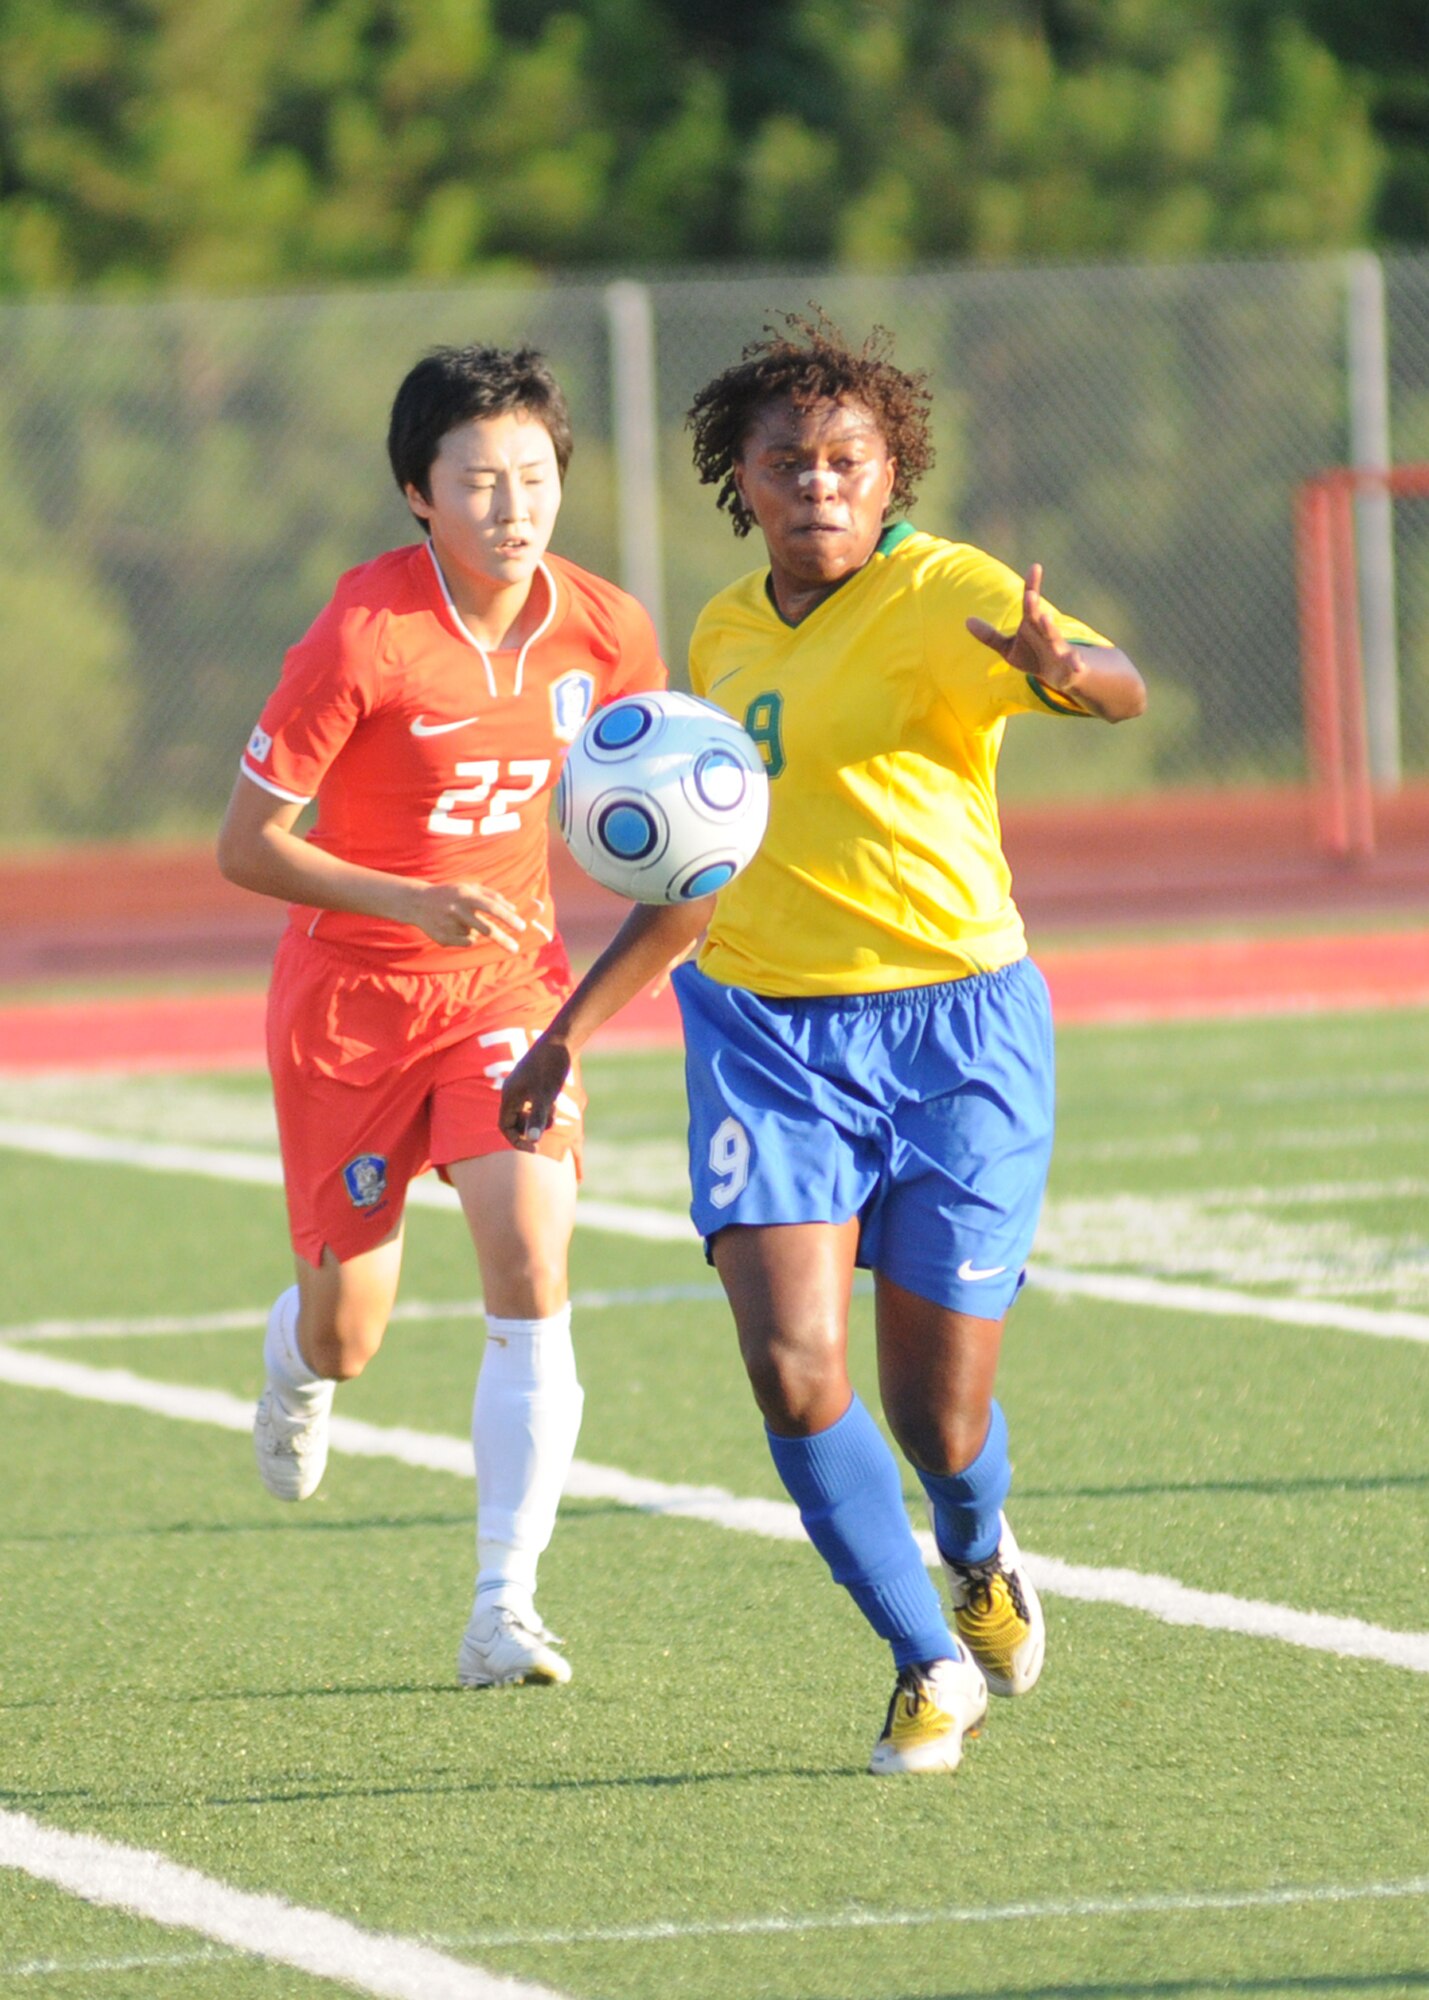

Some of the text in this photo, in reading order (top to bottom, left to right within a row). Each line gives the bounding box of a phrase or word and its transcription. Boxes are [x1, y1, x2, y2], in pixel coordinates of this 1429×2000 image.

[745, 689, 787, 780] 9
[427, 758, 551, 836] 22
[709, 1116, 751, 1210] 9
